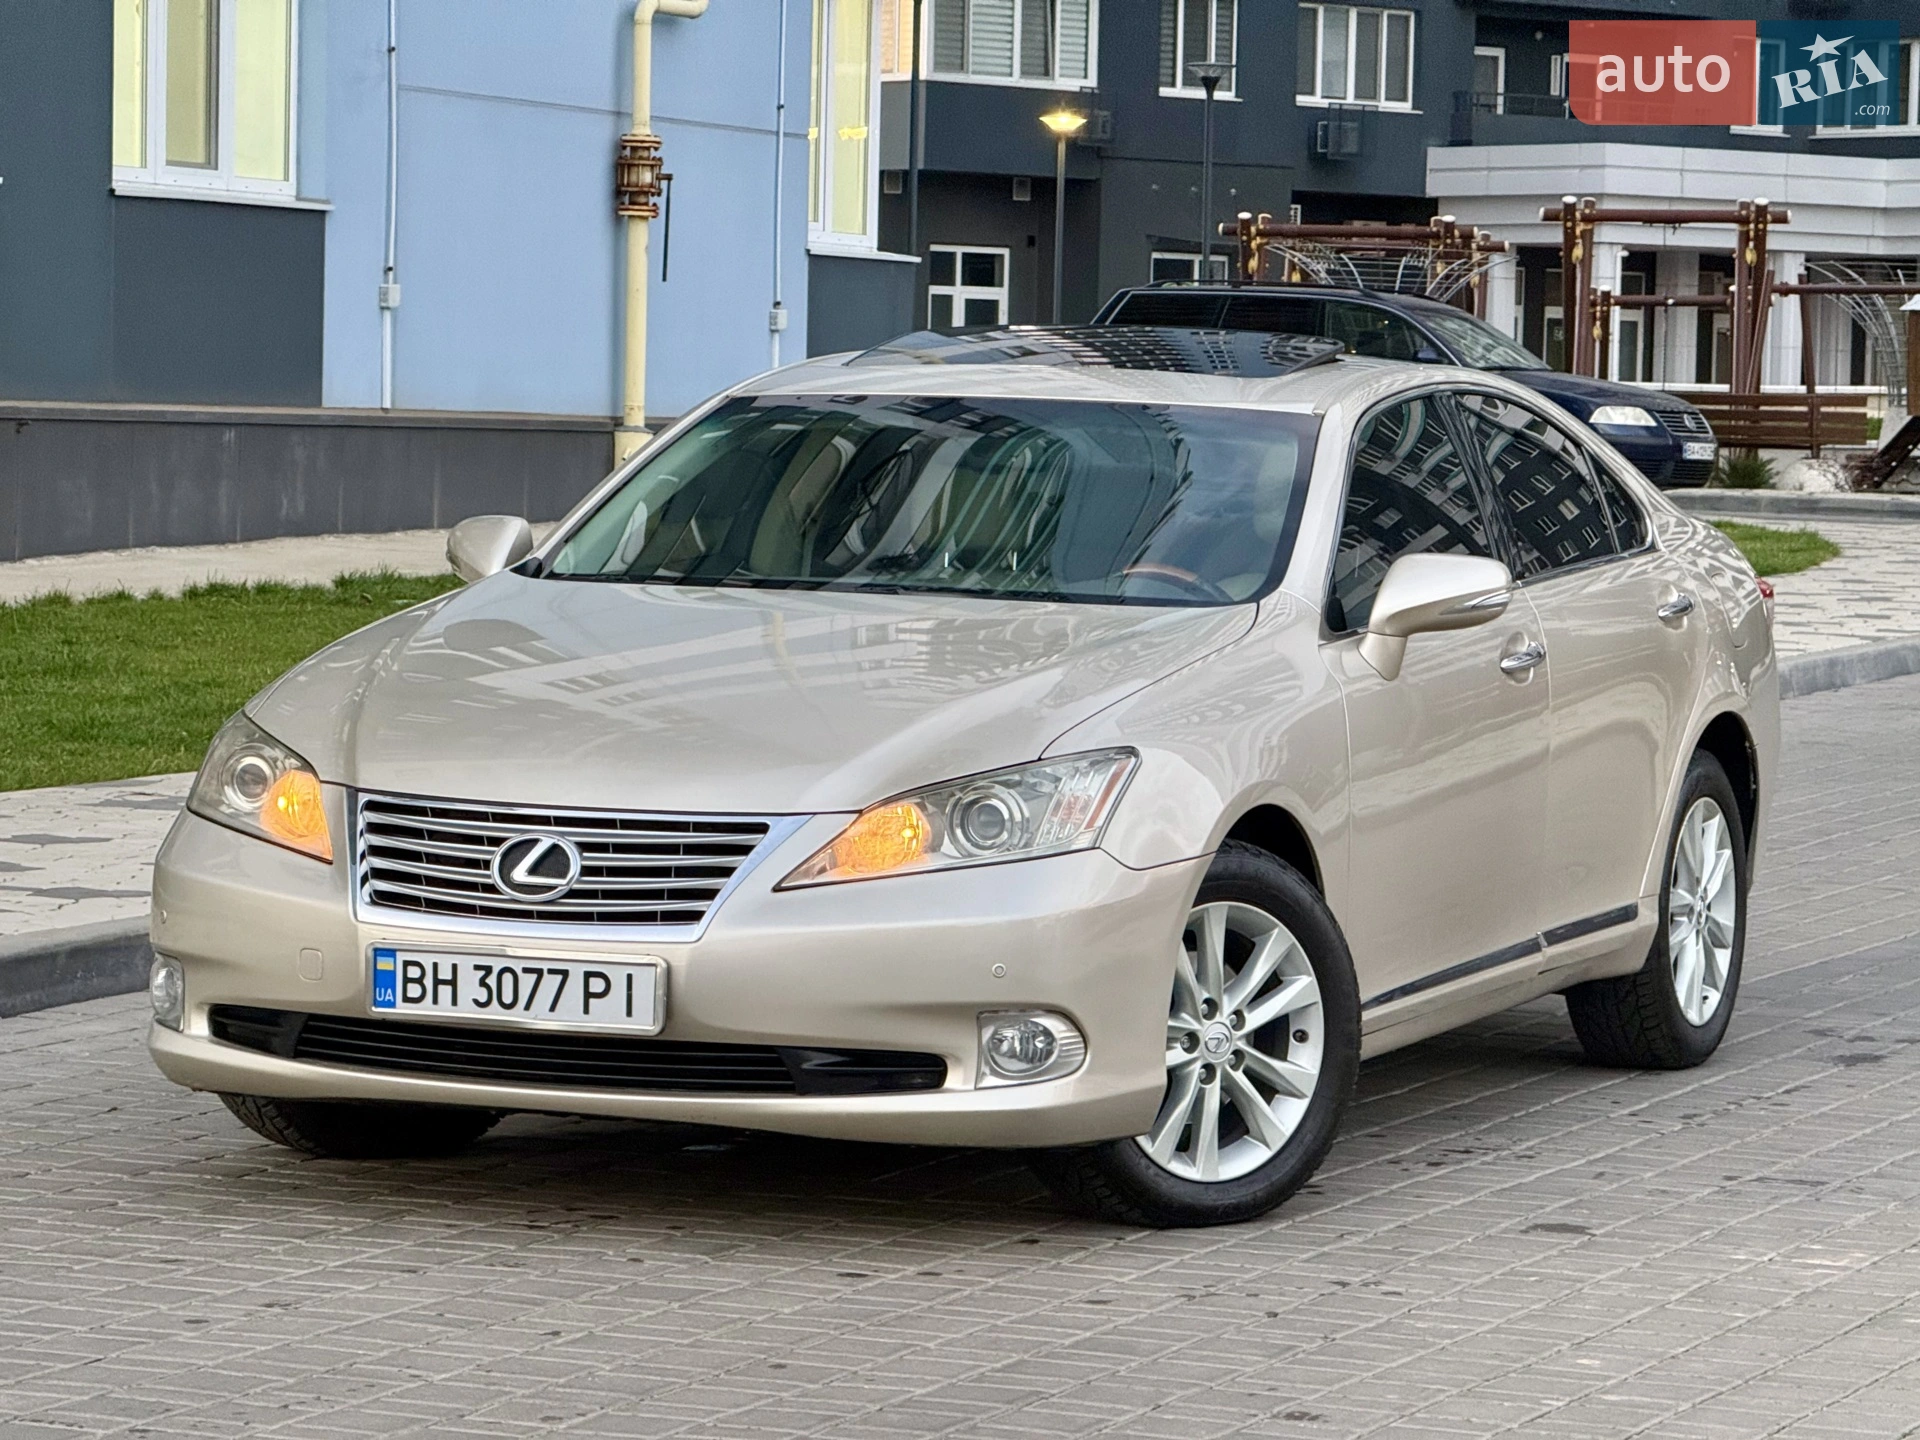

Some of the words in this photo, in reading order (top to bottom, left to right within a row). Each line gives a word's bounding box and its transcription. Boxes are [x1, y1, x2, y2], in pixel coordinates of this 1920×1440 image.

[375, 987, 394, 1002] UA
[401, 959, 458, 1007] BH
[471, 964, 570, 1013] 3077
